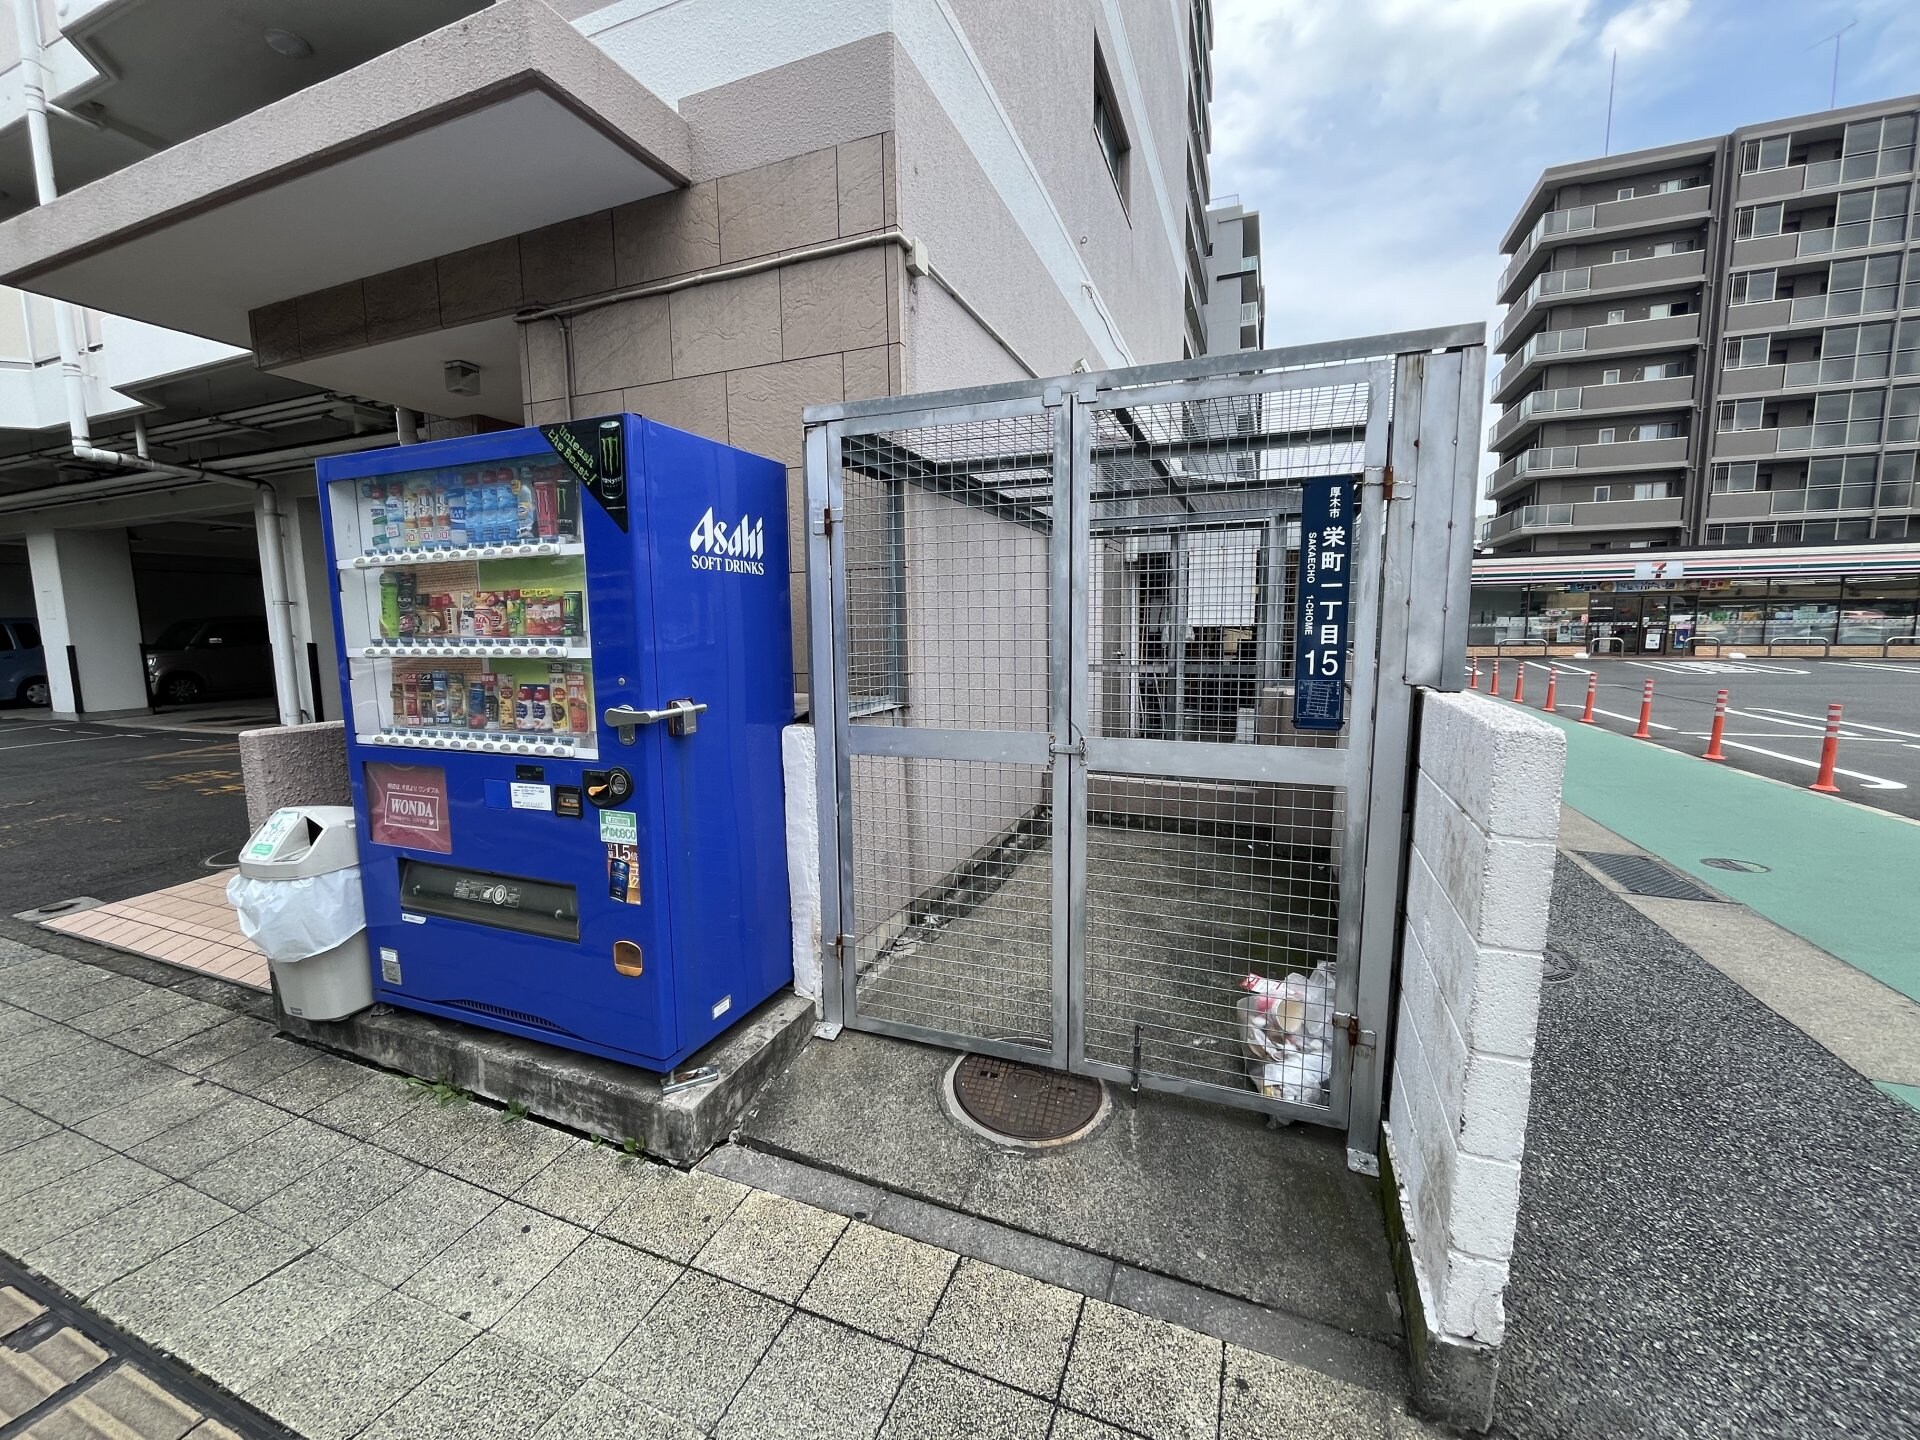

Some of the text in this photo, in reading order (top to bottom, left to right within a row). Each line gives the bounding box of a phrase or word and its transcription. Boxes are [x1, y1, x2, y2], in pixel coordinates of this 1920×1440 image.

[548, 429, 597, 486] the Beast!
[559, 425, 595, 468] Unleash
[1329, 486, 1342, 518] 厚木市
[690, 507, 764, 560] Asahi
[691, 555, 765, 576] SOFT DRINKS
[1304, 532, 1317, 635] SAKAECHO 1-CHOME
[1320, 526, 1345, 645] 栄町一丁目
[1305, 650, 1338, 676] 15
[391, 798, 433, 818] WONDA
